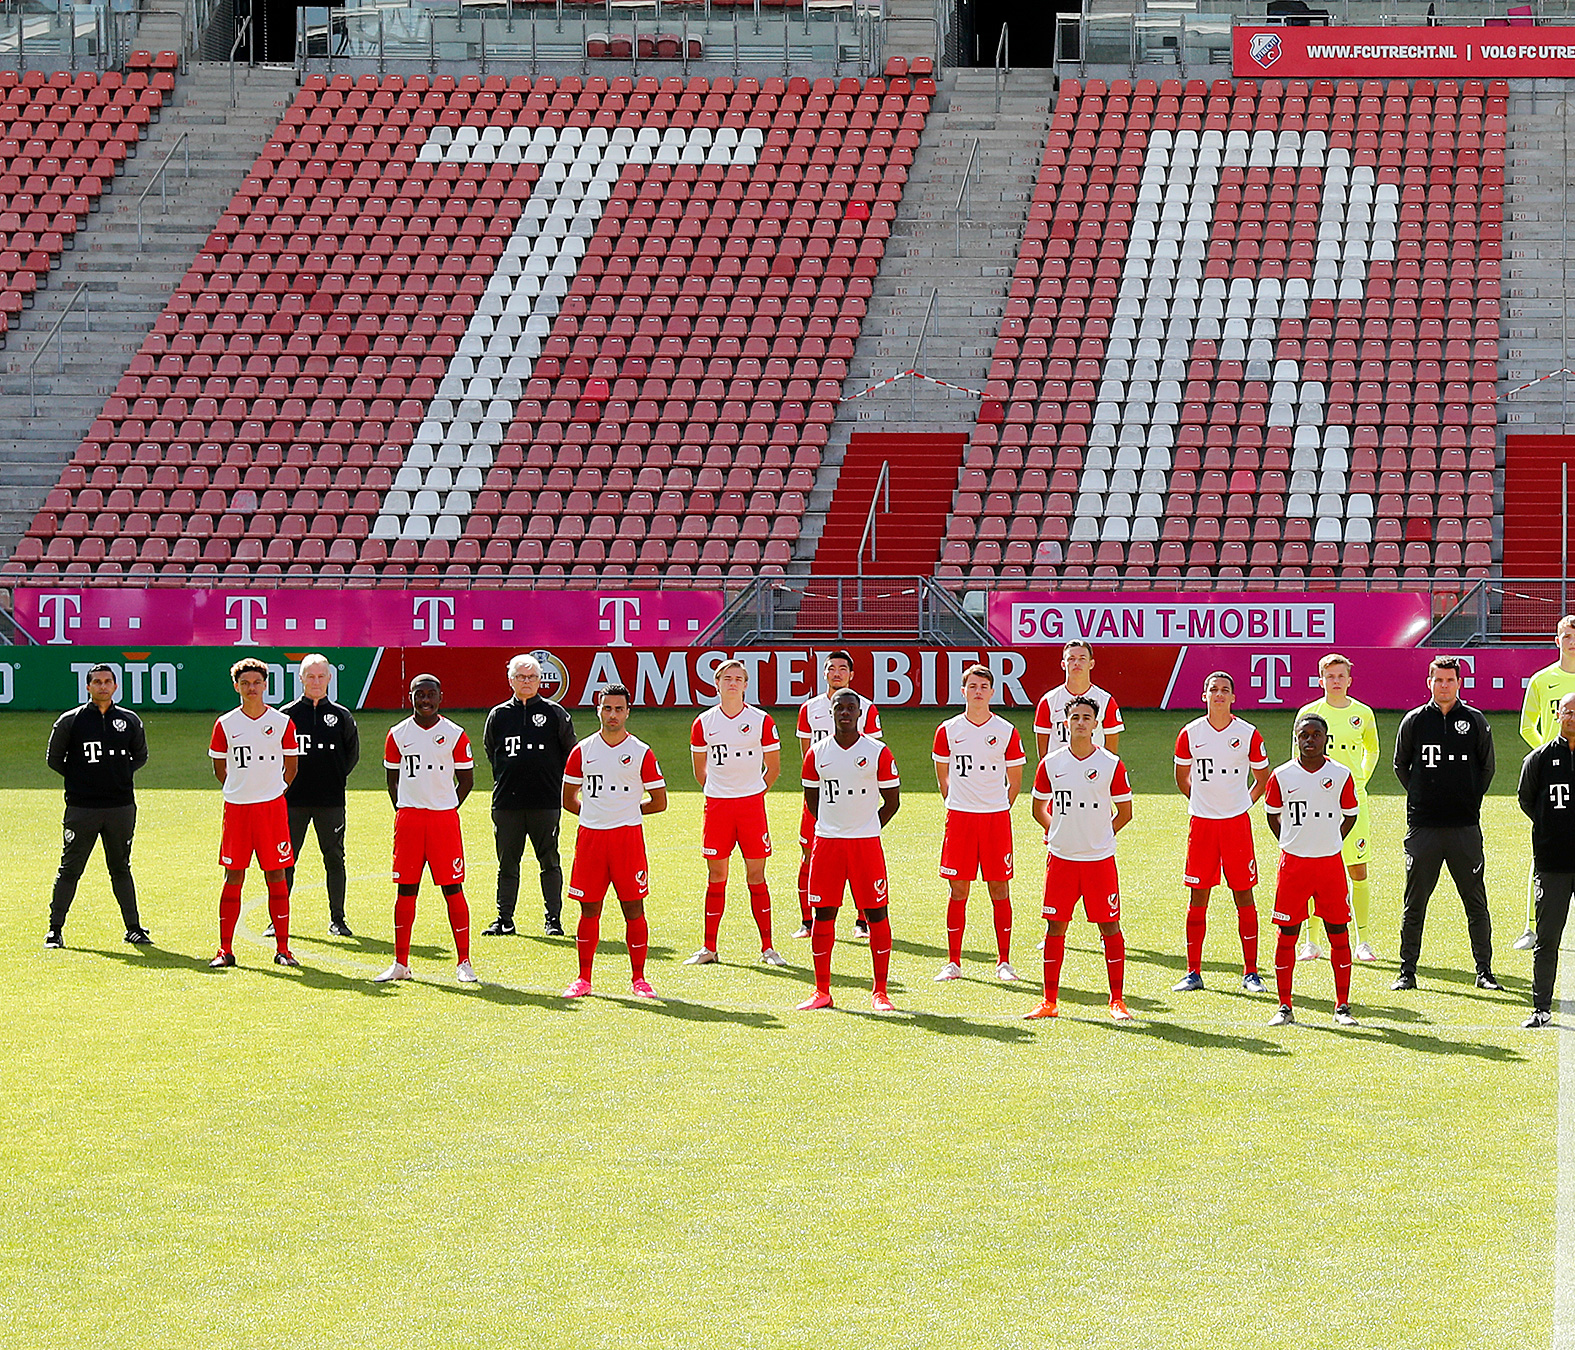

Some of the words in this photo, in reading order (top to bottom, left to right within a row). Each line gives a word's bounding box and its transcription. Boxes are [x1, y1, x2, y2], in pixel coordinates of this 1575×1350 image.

[1306, 45, 1457, 59] WWW.FCUTRECHT.NL
[1481, 45, 1517, 59] VOLG
[1519, 45, 1536, 59] FC
[39, 595, 81, 644] T
[225, 596, 268, 645] T
[413, 596, 455, 646] T
[599, 597, 641, 646] T
[1018, 608, 1064, 639] 5G
[1075, 608, 1144, 639] VAN
[1156, 608, 1326, 639] T-MOBILE
[871, 651, 1034, 706] BIER
[1251, 654, 1291, 704] T
[83, 741, 102, 764] T
[233, 745, 251, 769] T
[298, 734, 312, 756] T
[504, 735, 521, 757] T
[711, 744, 728, 766] T
[1422, 744, 1441, 768] T
[404, 754, 420, 778] T
[955, 754, 972, 778] T
[1196, 758, 1213, 782] T
[587, 774, 603, 798] T
[824, 779, 840, 804] T
[1550, 783, 1570, 809] T
[1054, 790, 1072, 816] T
[1288, 800, 1307, 827] T
